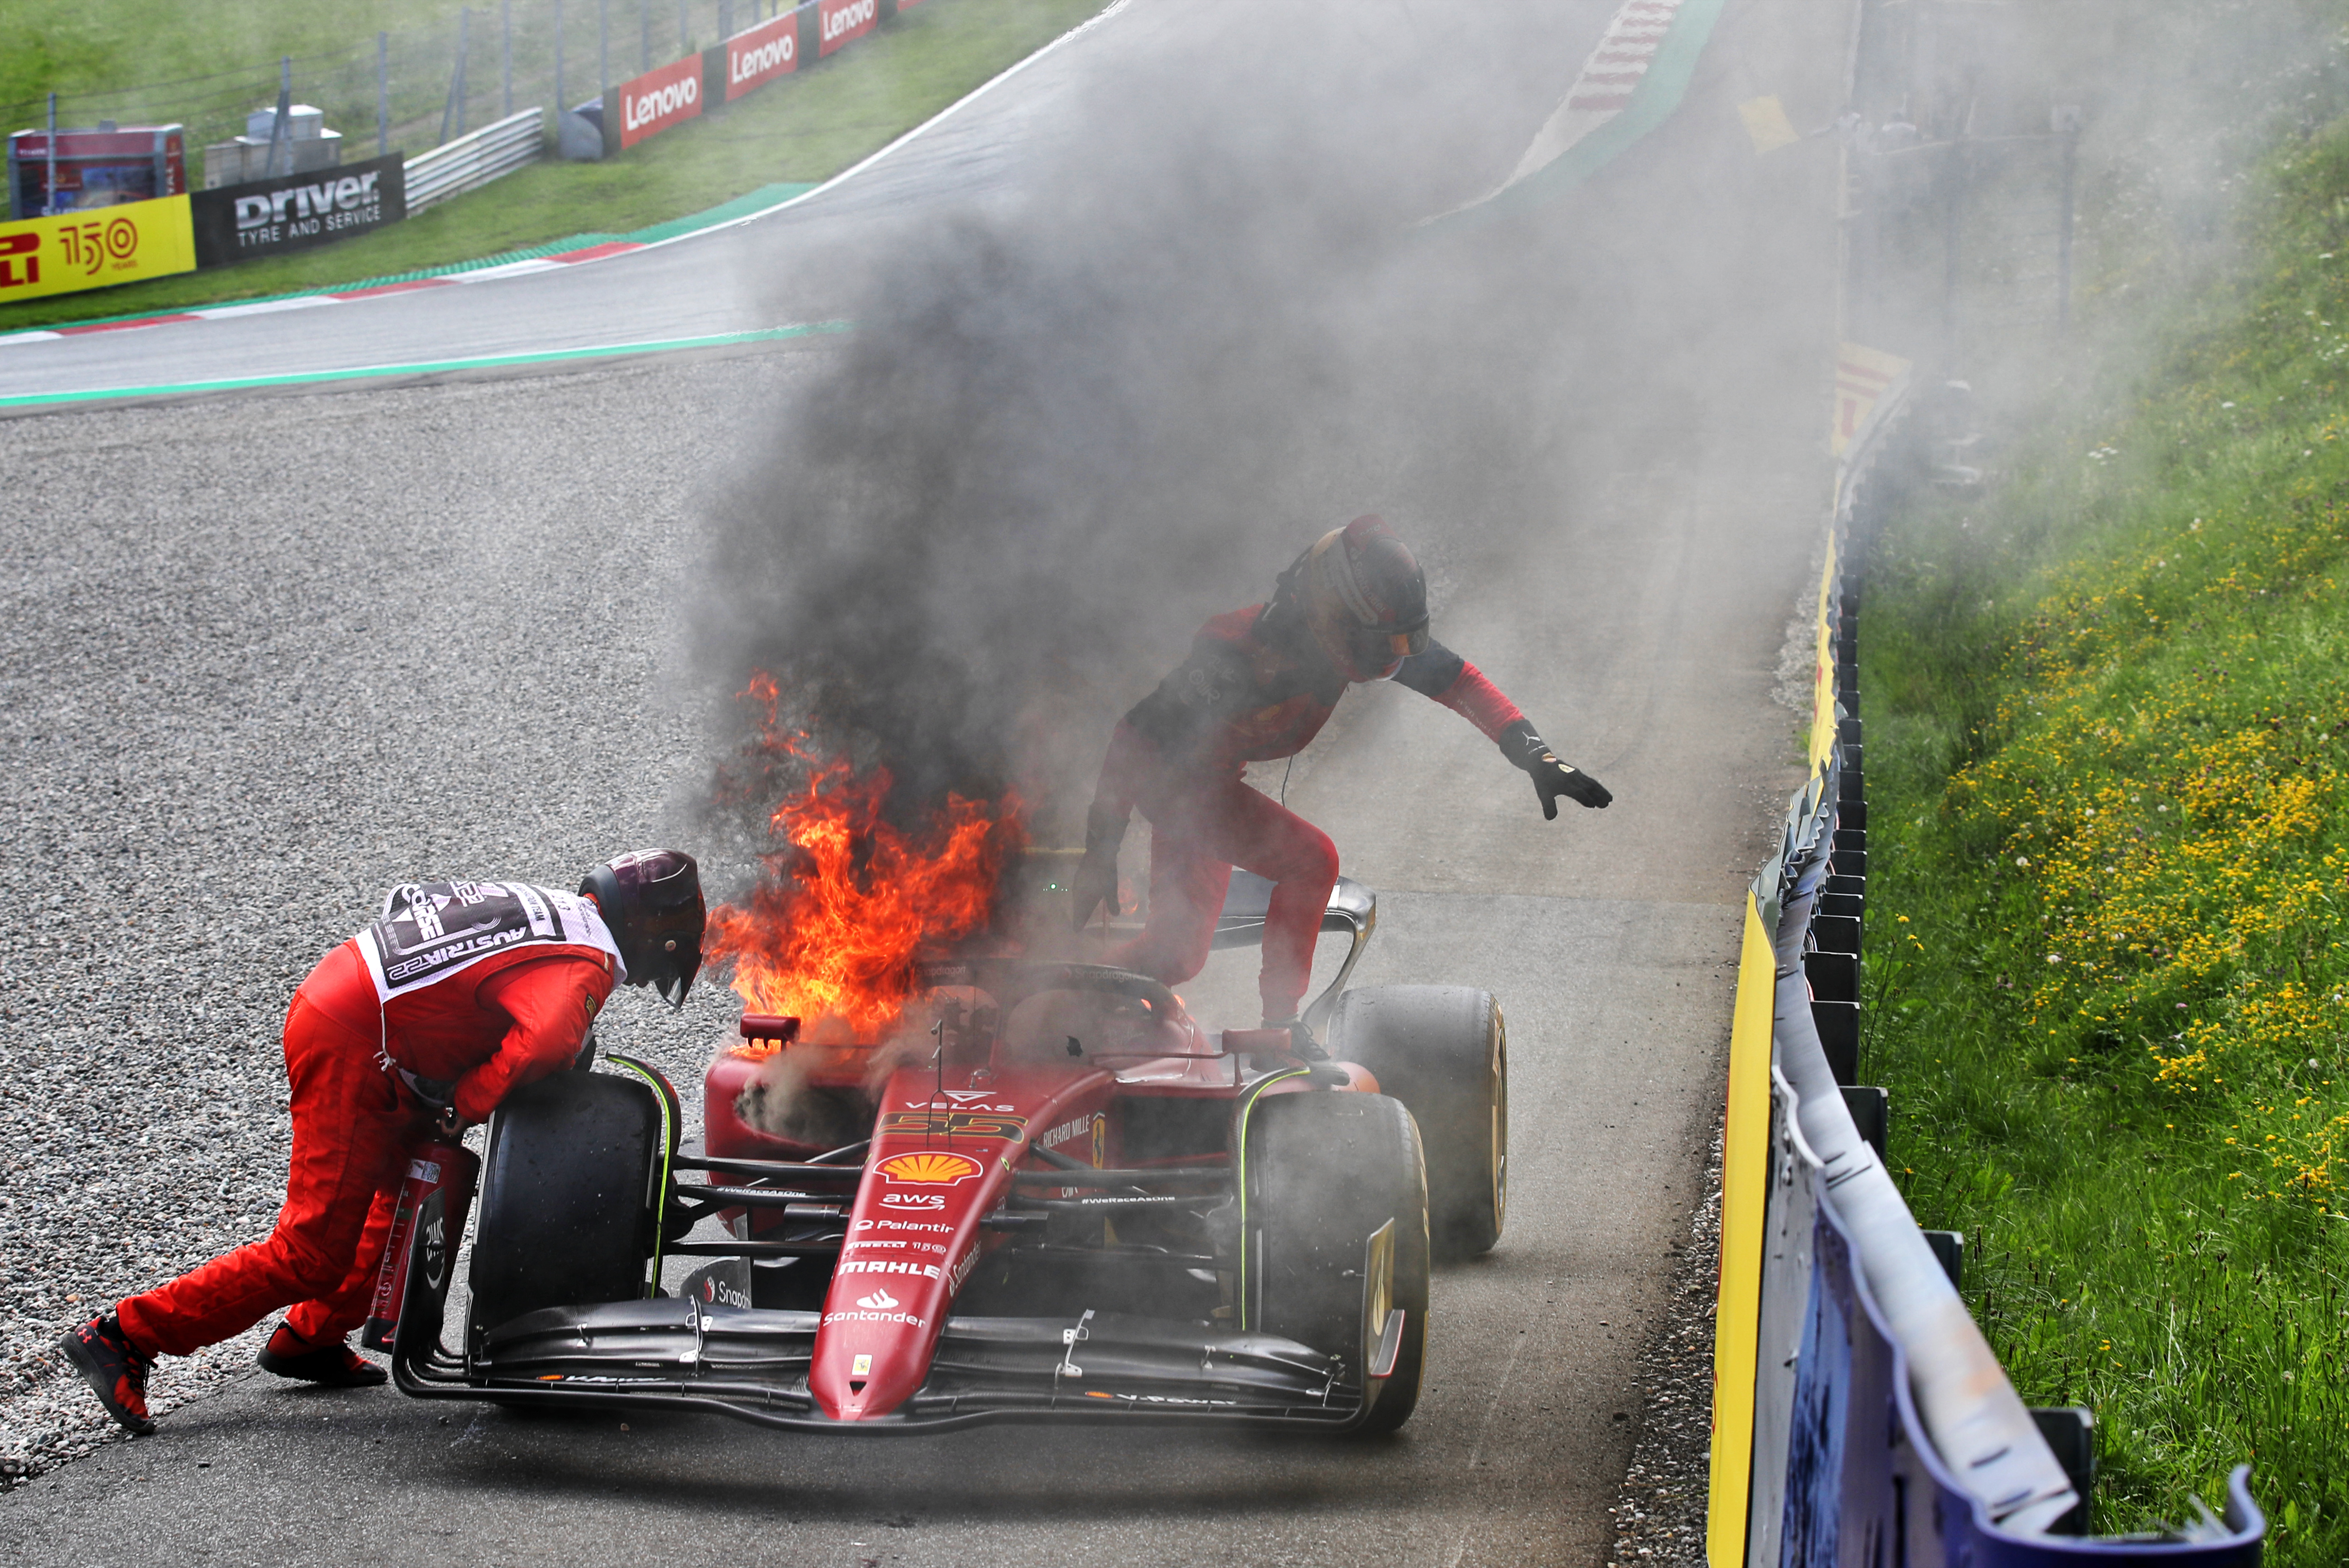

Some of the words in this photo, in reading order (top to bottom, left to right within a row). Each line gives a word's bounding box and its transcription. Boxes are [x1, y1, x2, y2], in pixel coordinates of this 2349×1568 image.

[821, 0, 875, 41] Lenovo
[731, 35, 794, 84] Lenovo
[626, 76, 698, 131] Lenovo
[238, 225, 282, 247] TYRE
[288, 217, 321, 240] AND
[325, 203, 382, 232] SERVICE
[531, 906, 545, 921] TEAM
[1075, 967, 1135, 982] Snapdragon
[905, 1101, 1014, 1112] VELAS
[872, 1111, 1028, 1143] 55
[1043, 1122, 1070, 1148] RICHARD
[1071, 1114, 1090, 1138] MILLE
[717, 1186, 806, 1197] #WeRaceAsOne
[883, 1193, 945, 1205] aws
[1081, 1196, 1175, 1204] #WeRaceAsOne
[877, 1220, 954, 1233] Palantir
[838, 1261, 941, 1280] MAHLE
[953, 1240, 981, 1289] Santander
[823, 1310, 926, 1328] Santander
